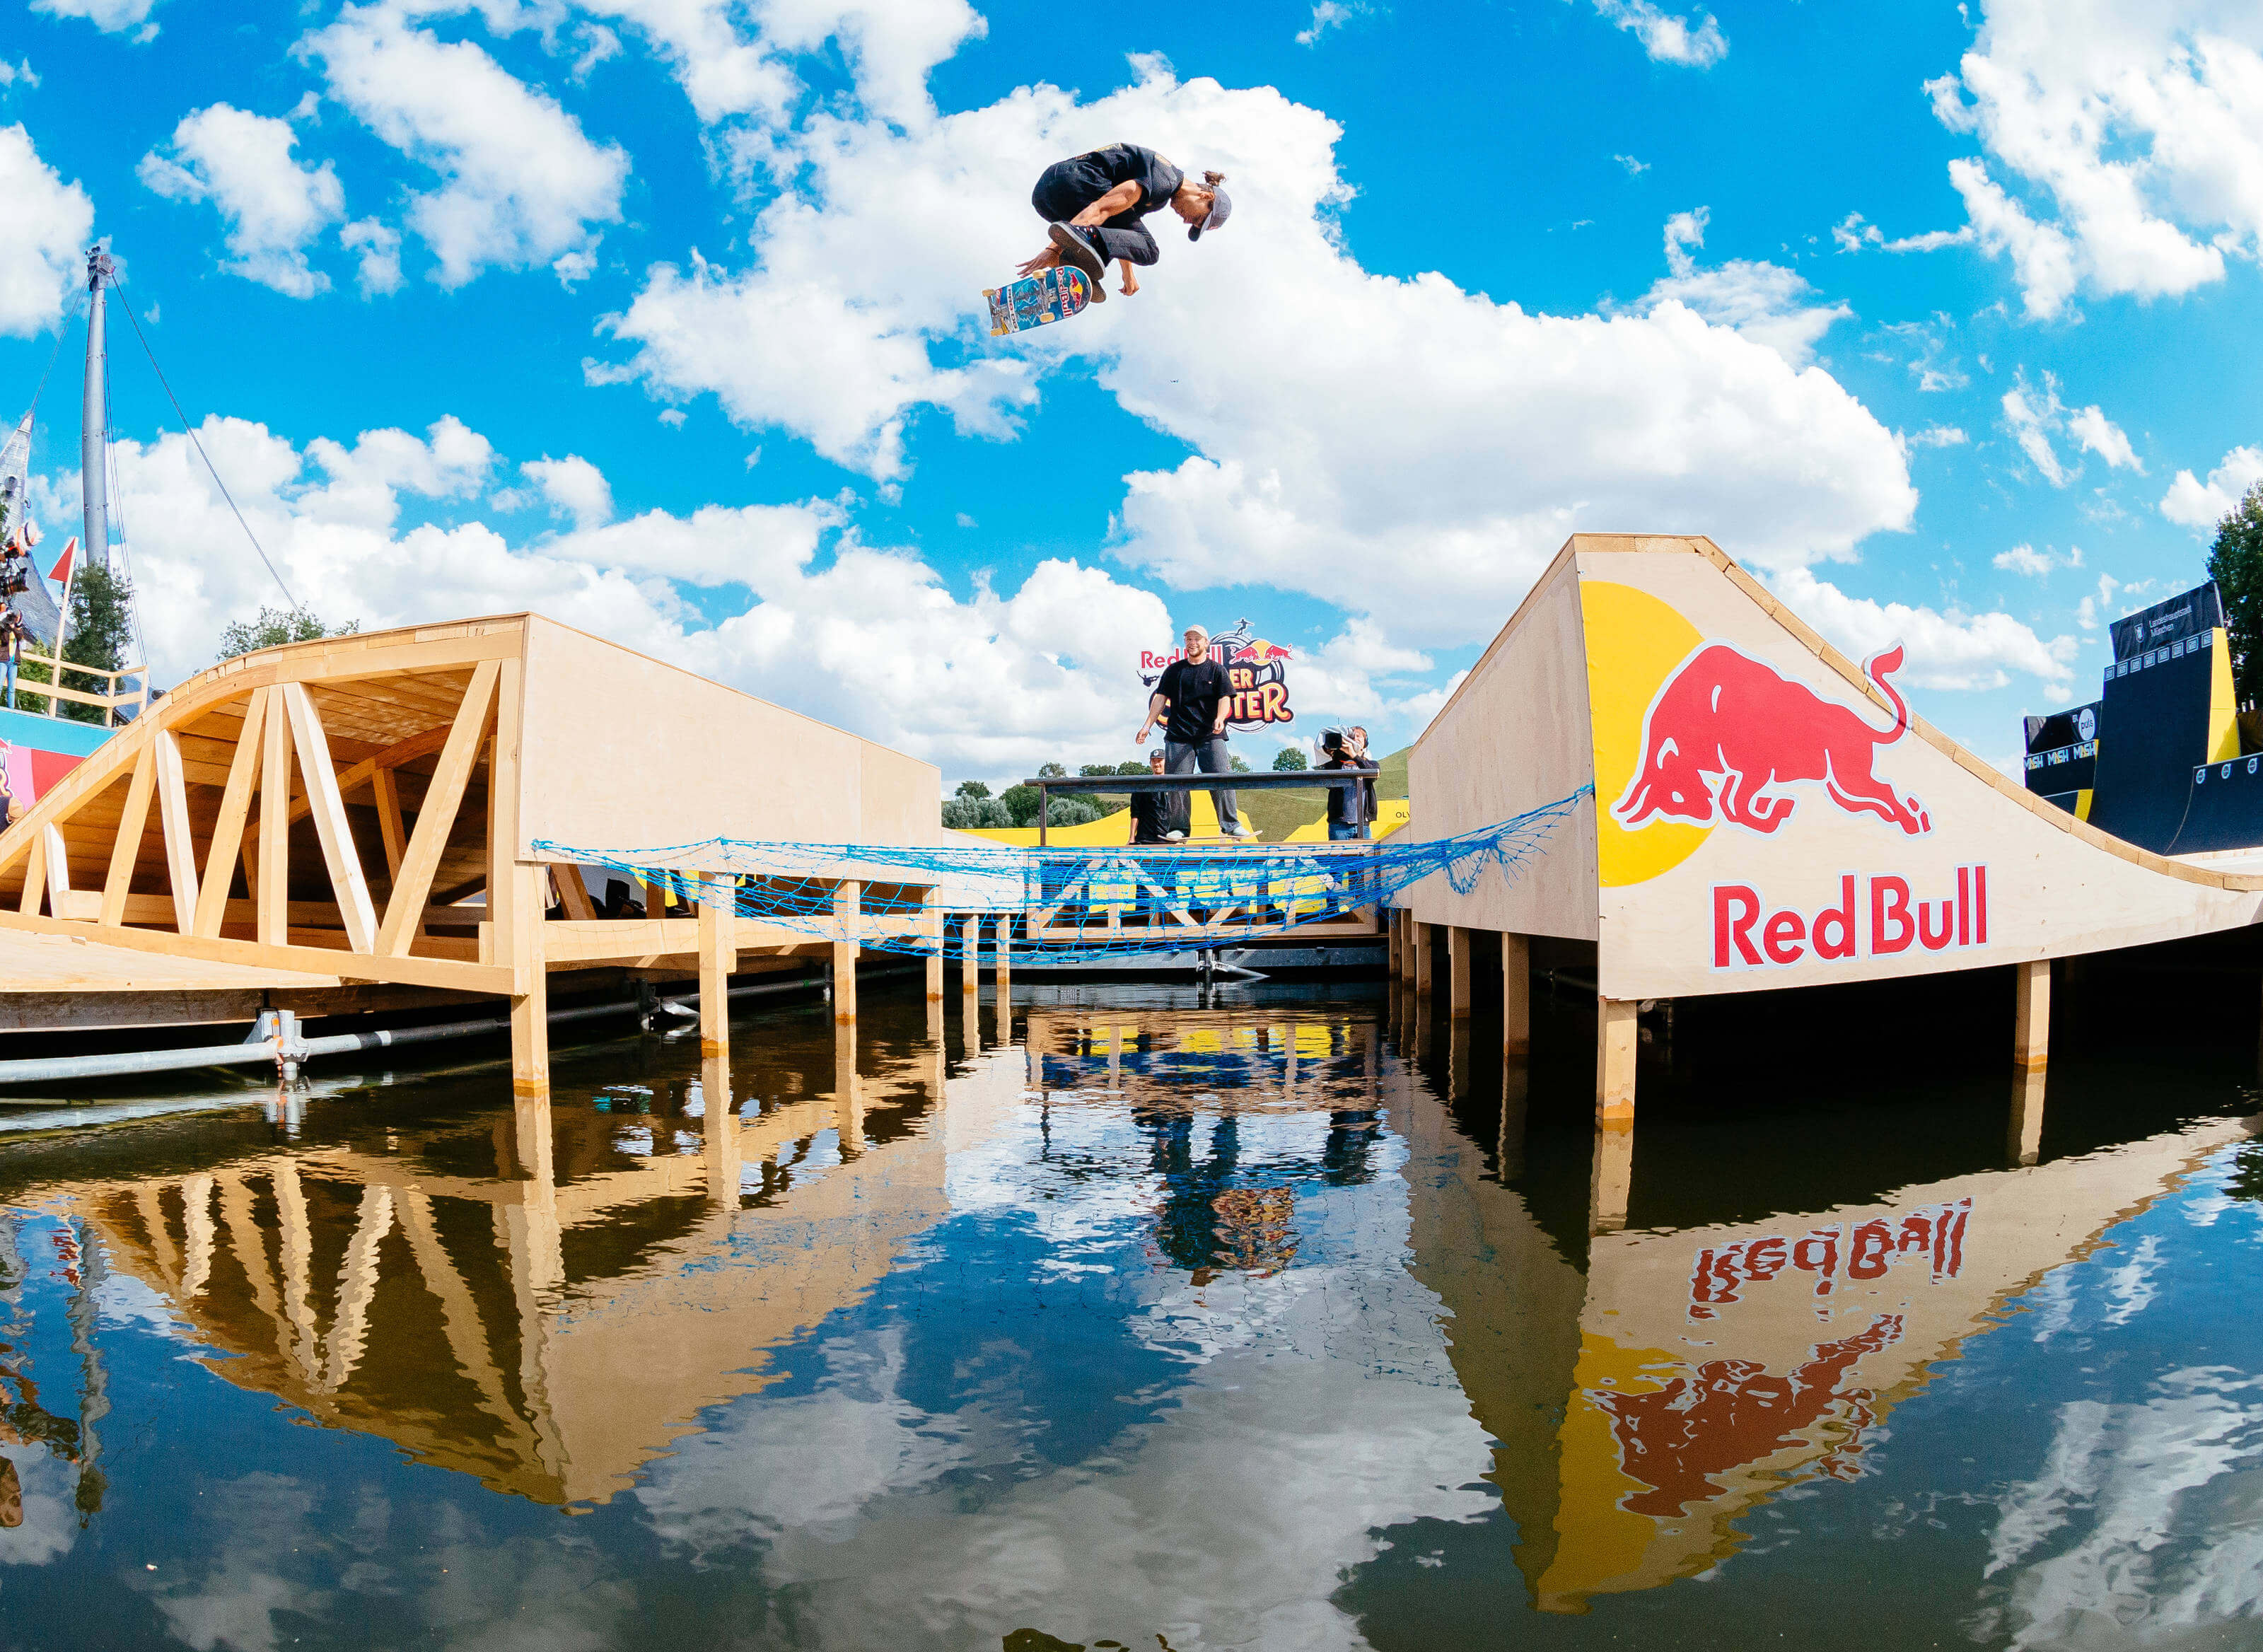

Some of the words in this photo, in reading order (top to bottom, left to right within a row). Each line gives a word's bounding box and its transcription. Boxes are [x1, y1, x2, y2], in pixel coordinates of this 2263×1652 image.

[1056, 268, 1069, 292] Red
[1060, 292, 1074, 317] Bull
[2148, 605, 2192, 627] Landeshauptstadt
[2151, 623, 2175, 637] München
[2081, 719, 2093, 733] puls
[2047, 749, 2069, 766] MASH
[2073, 742, 2095, 760] MASH
[1714, 875, 1856, 967] Red
[1871, 866, 1986, 954] Bull
